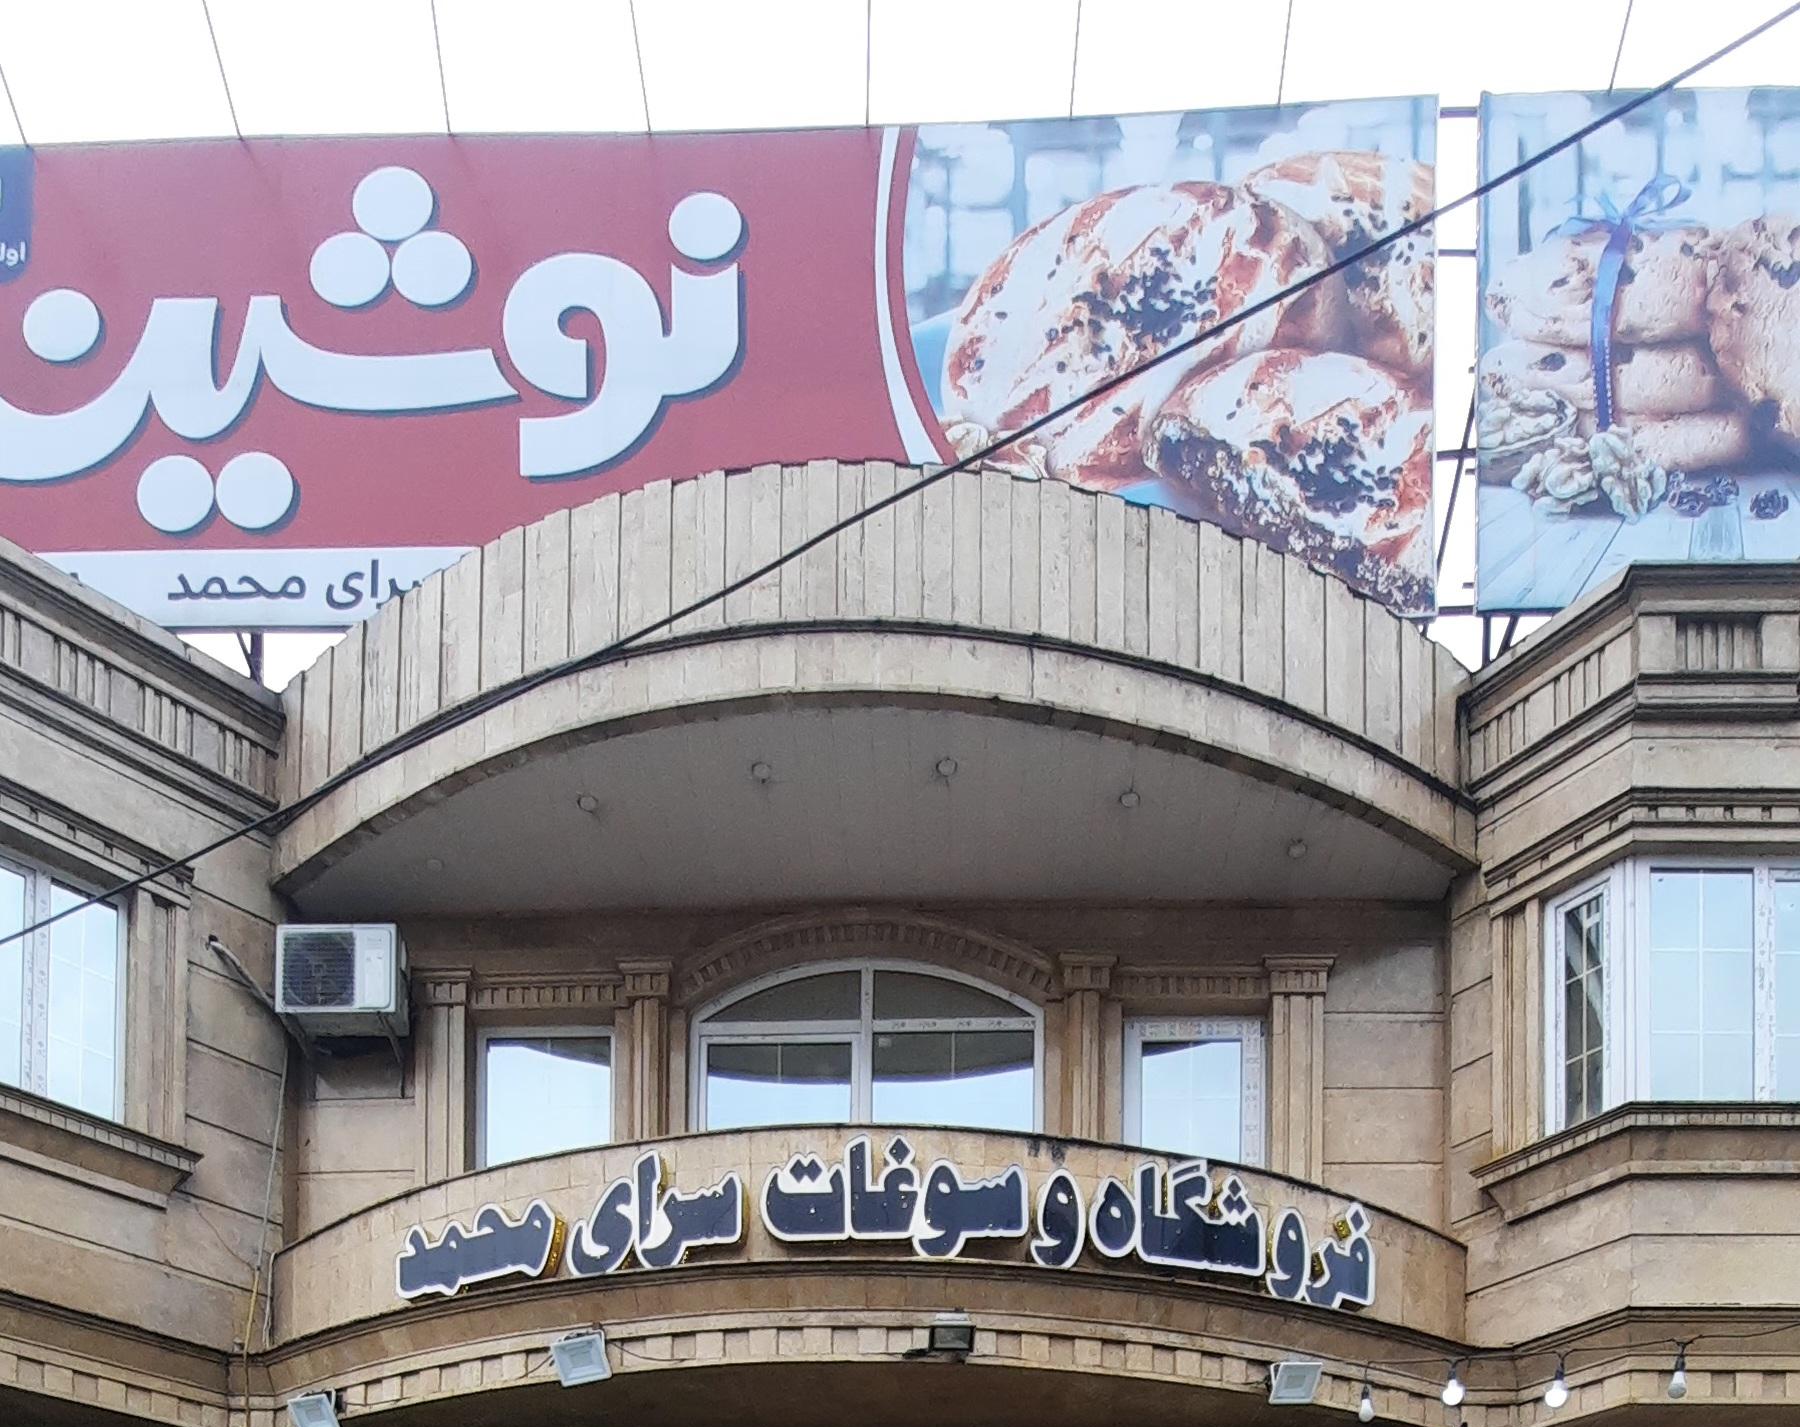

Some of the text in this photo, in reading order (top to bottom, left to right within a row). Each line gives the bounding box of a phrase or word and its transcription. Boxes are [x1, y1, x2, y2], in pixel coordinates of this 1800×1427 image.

[0, 165, 743, 534] نوشین
[167, 573, 307, 601] محمد
[395, 1134, 1376, 1309] فروشگاه و سوغات سرای محمد
